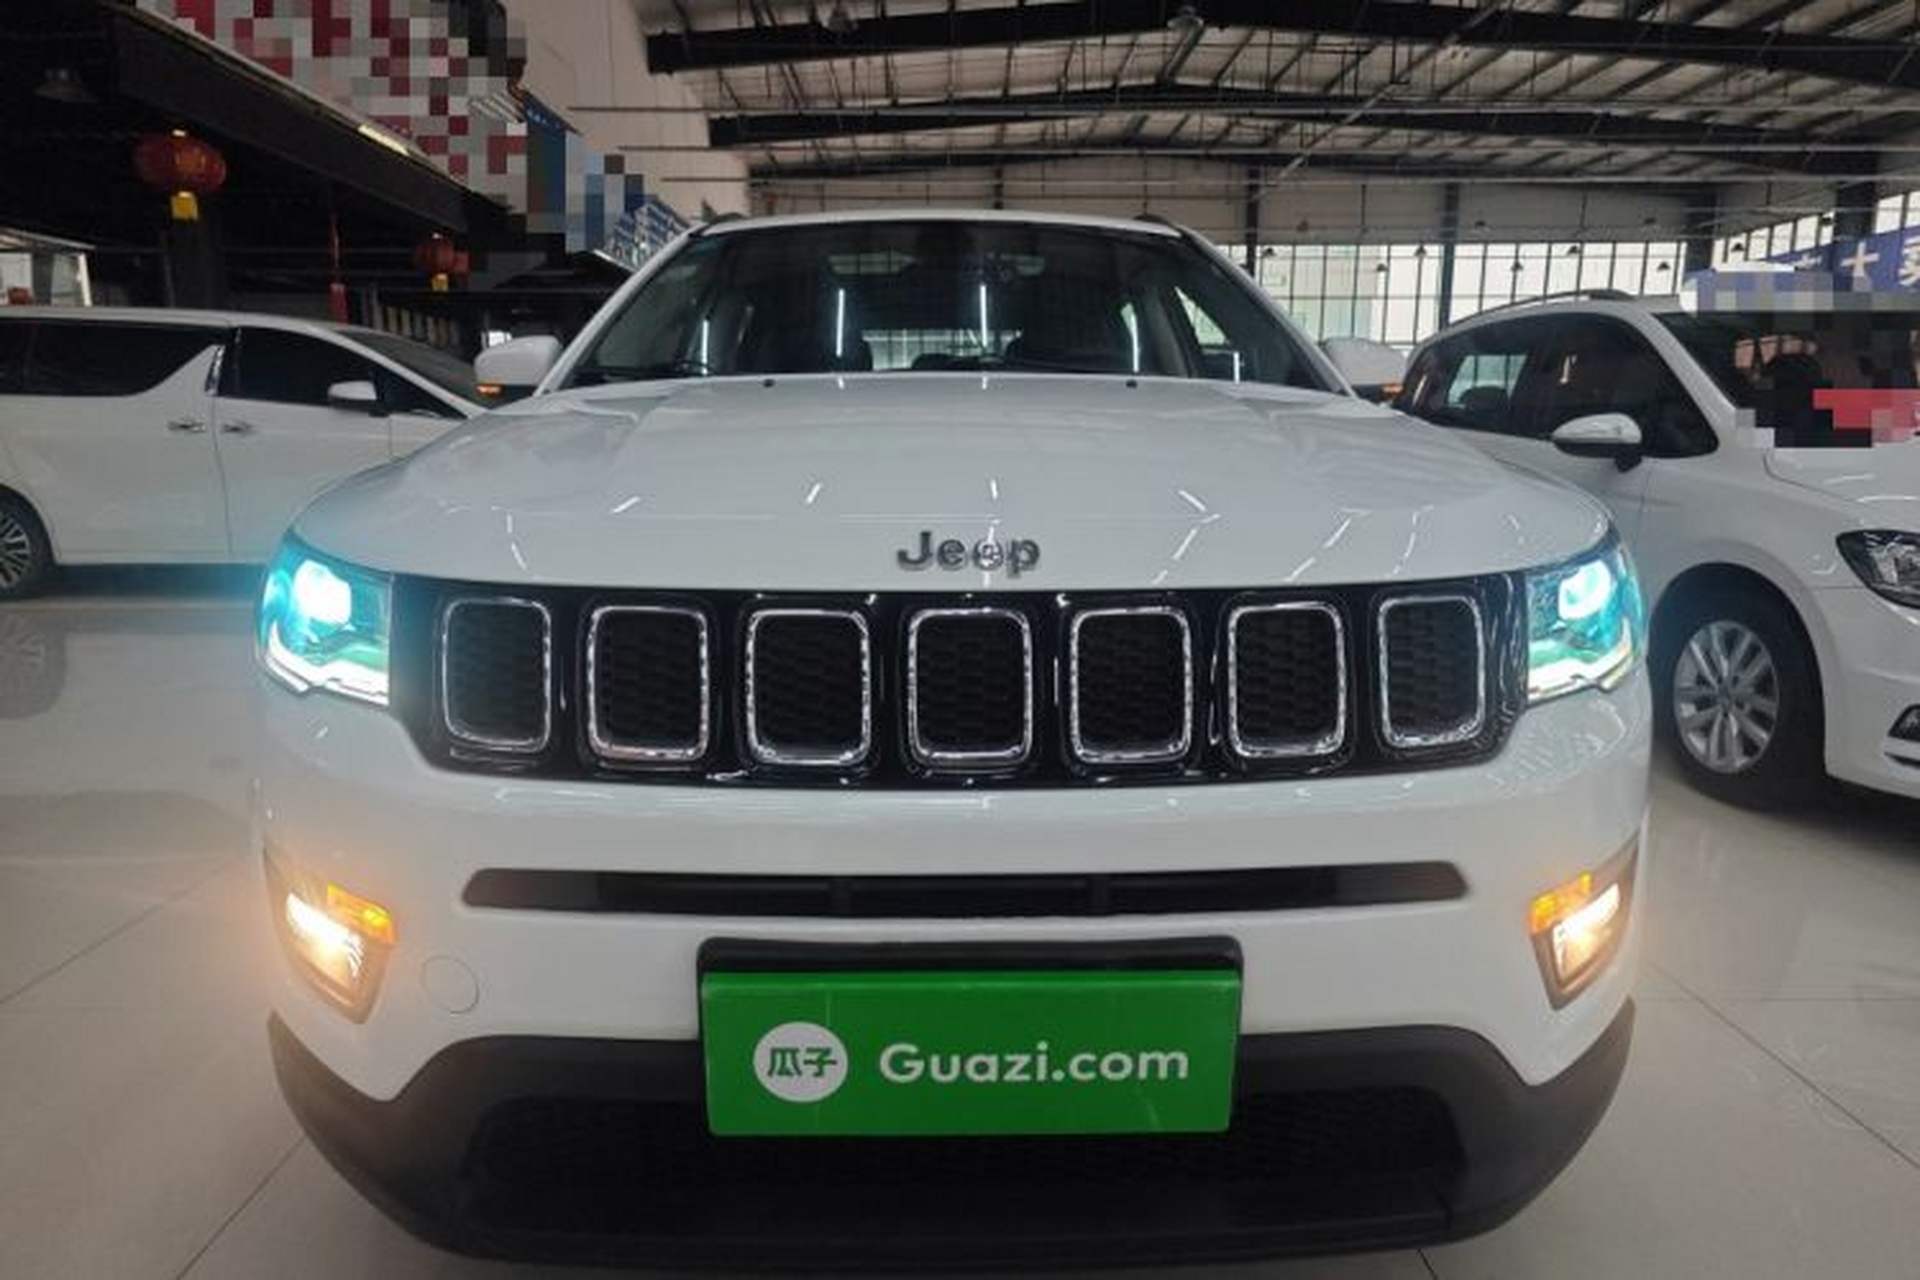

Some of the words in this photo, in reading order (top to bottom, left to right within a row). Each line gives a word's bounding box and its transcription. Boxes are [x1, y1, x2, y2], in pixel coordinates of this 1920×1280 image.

[897, 530, 1041, 579] Jeep
[767, 1046, 838, 1078] 瓜子
[879, 1041, 1190, 1083] Guazi.com
